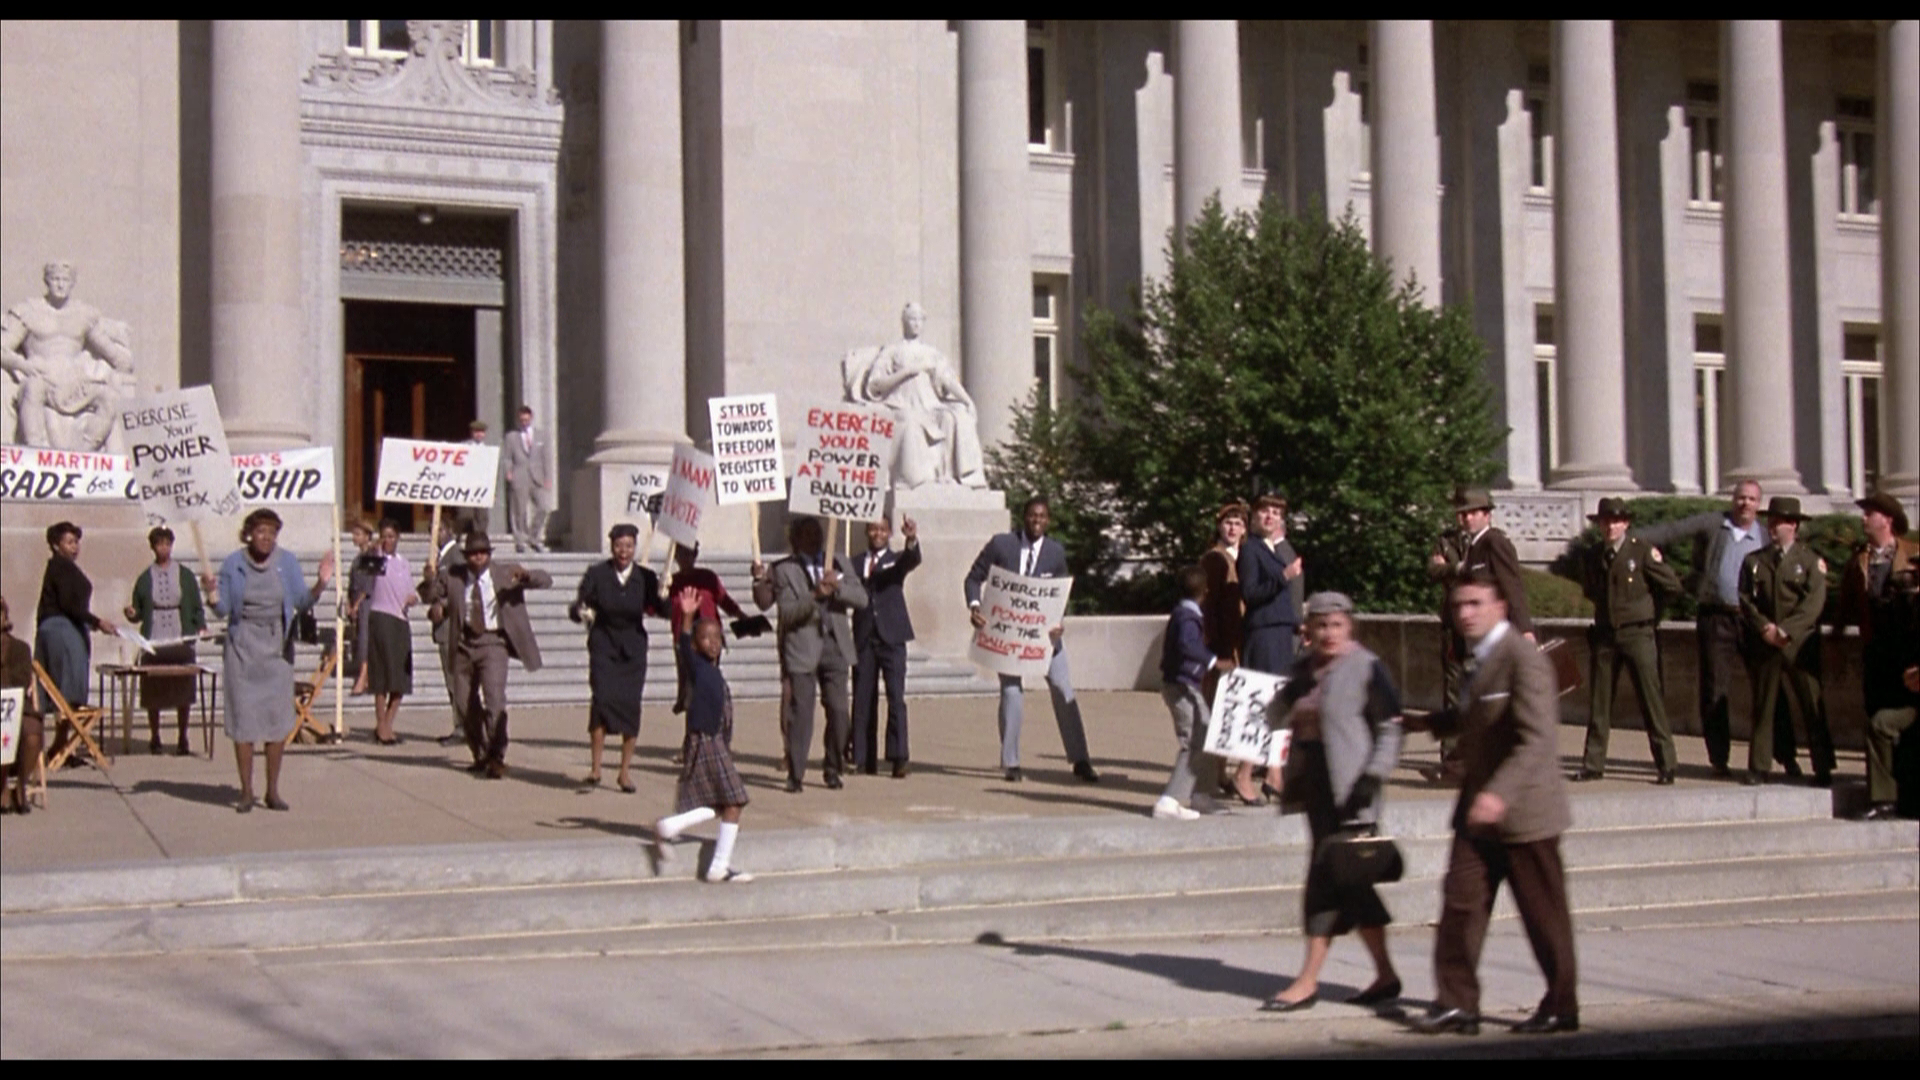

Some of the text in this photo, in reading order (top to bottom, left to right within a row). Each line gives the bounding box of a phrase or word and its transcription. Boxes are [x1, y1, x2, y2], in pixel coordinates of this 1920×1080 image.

[720, 402, 767, 419] STRIDE
[716, 419, 773, 436] TOWARDS
[132, 436, 217, 467] POWER
[718, 438, 775, 455] FREEDOM
[819, 434, 870, 451] YOUR
[37, 451, 113, 471] MARTIN
[412, 446, 469, 467] VOTE
[808, 448, 881, 469] POWER
[417, 466, 446, 481] for
[681, 458, 714, 493] MAN
[718, 459, 777, 475] REGISTER
[798, 463, 876, 485] AT THE
[142, 480, 195, 500] BALLOT
[384, 481, 488, 503] FREEDOM!!
[722, 477, 776, 493] TO VOTE
[810, 480, 879, 501] BALLOT
[174, 490, 210, 509] BOX
[991, 576, 1060, 598] EXERCISE
[1010, 596, 1040, 612] YOUR
[991, 605, 1047, 626] POWER
[991, 622, 1041, 639] AT THE
